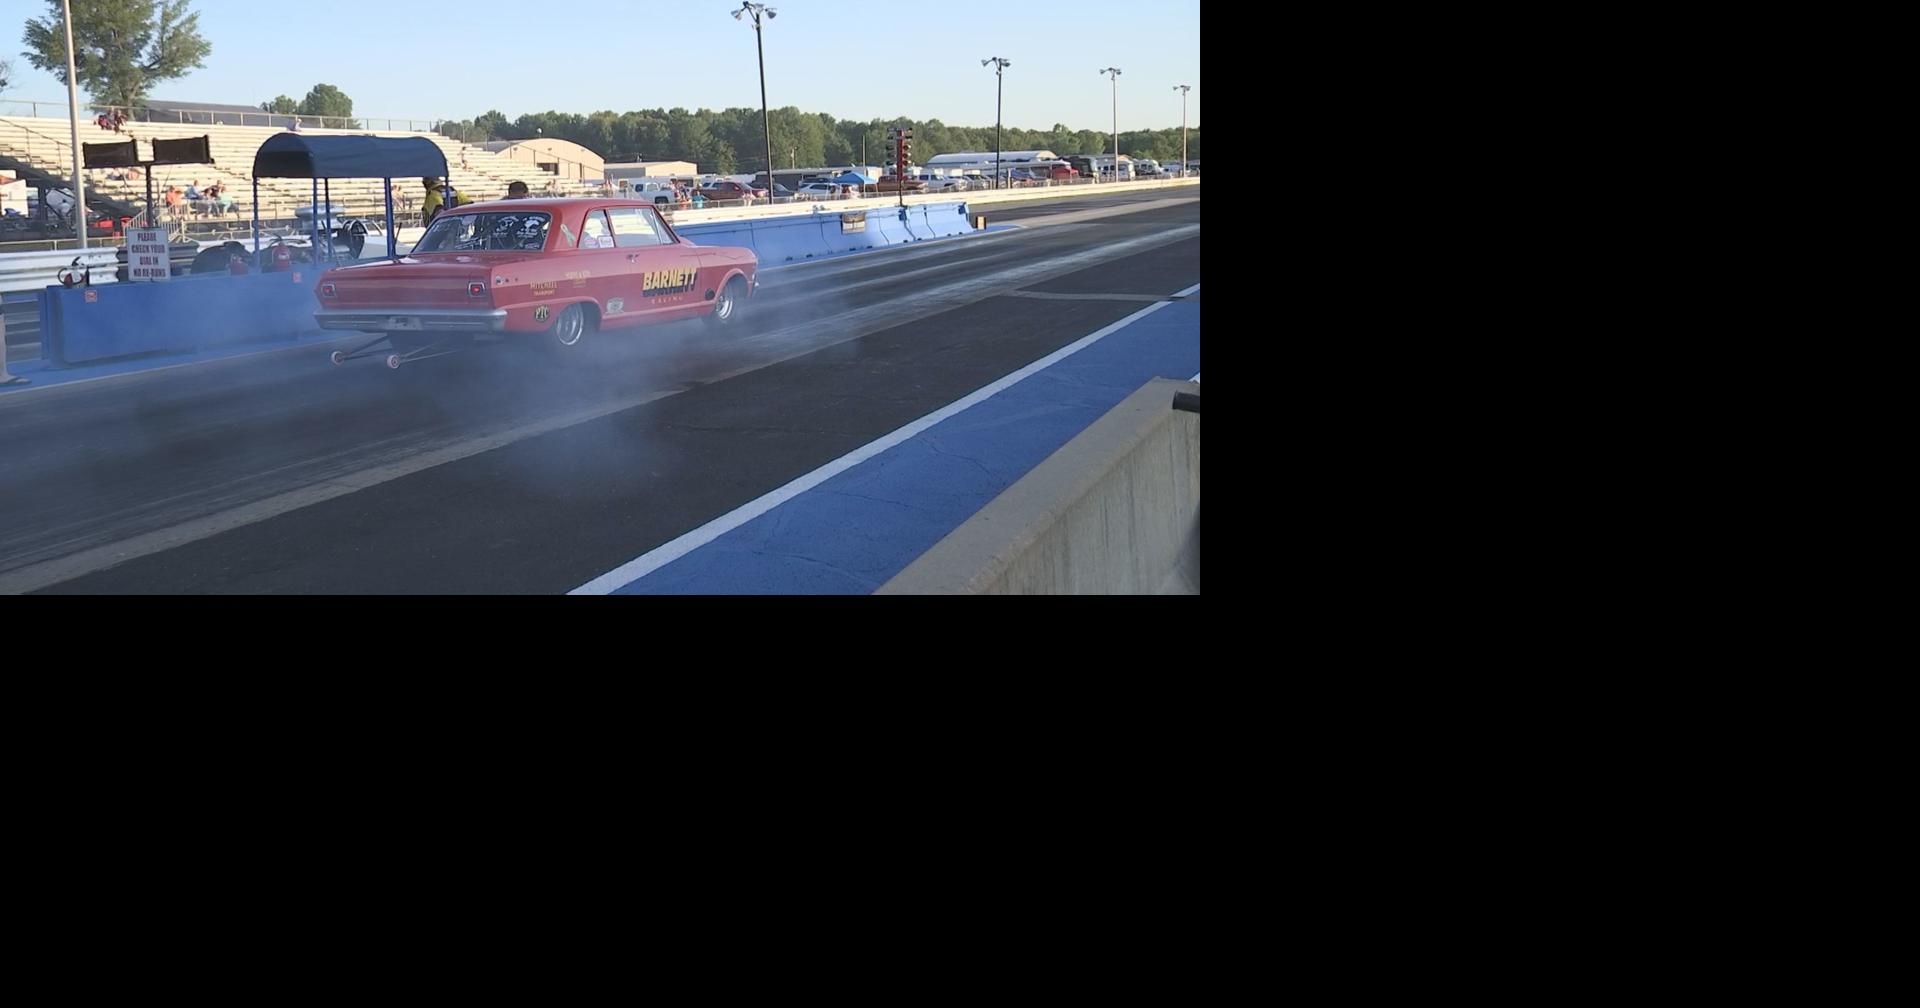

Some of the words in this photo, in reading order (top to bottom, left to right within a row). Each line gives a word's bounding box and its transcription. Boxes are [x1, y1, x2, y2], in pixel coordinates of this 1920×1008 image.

[137, 232, 156, 241] PLEASE
[131, 244, 149, 253] CHECK
[150, 244, 165, 253] YOUR
[139, 256, 152, 265] DIAL
[152, 256, 159, 265] IN
[133, 268, 141, 277] NO
[642, 267, 697, 291] BARNETT
[535, 305, 549, 319] PTC
